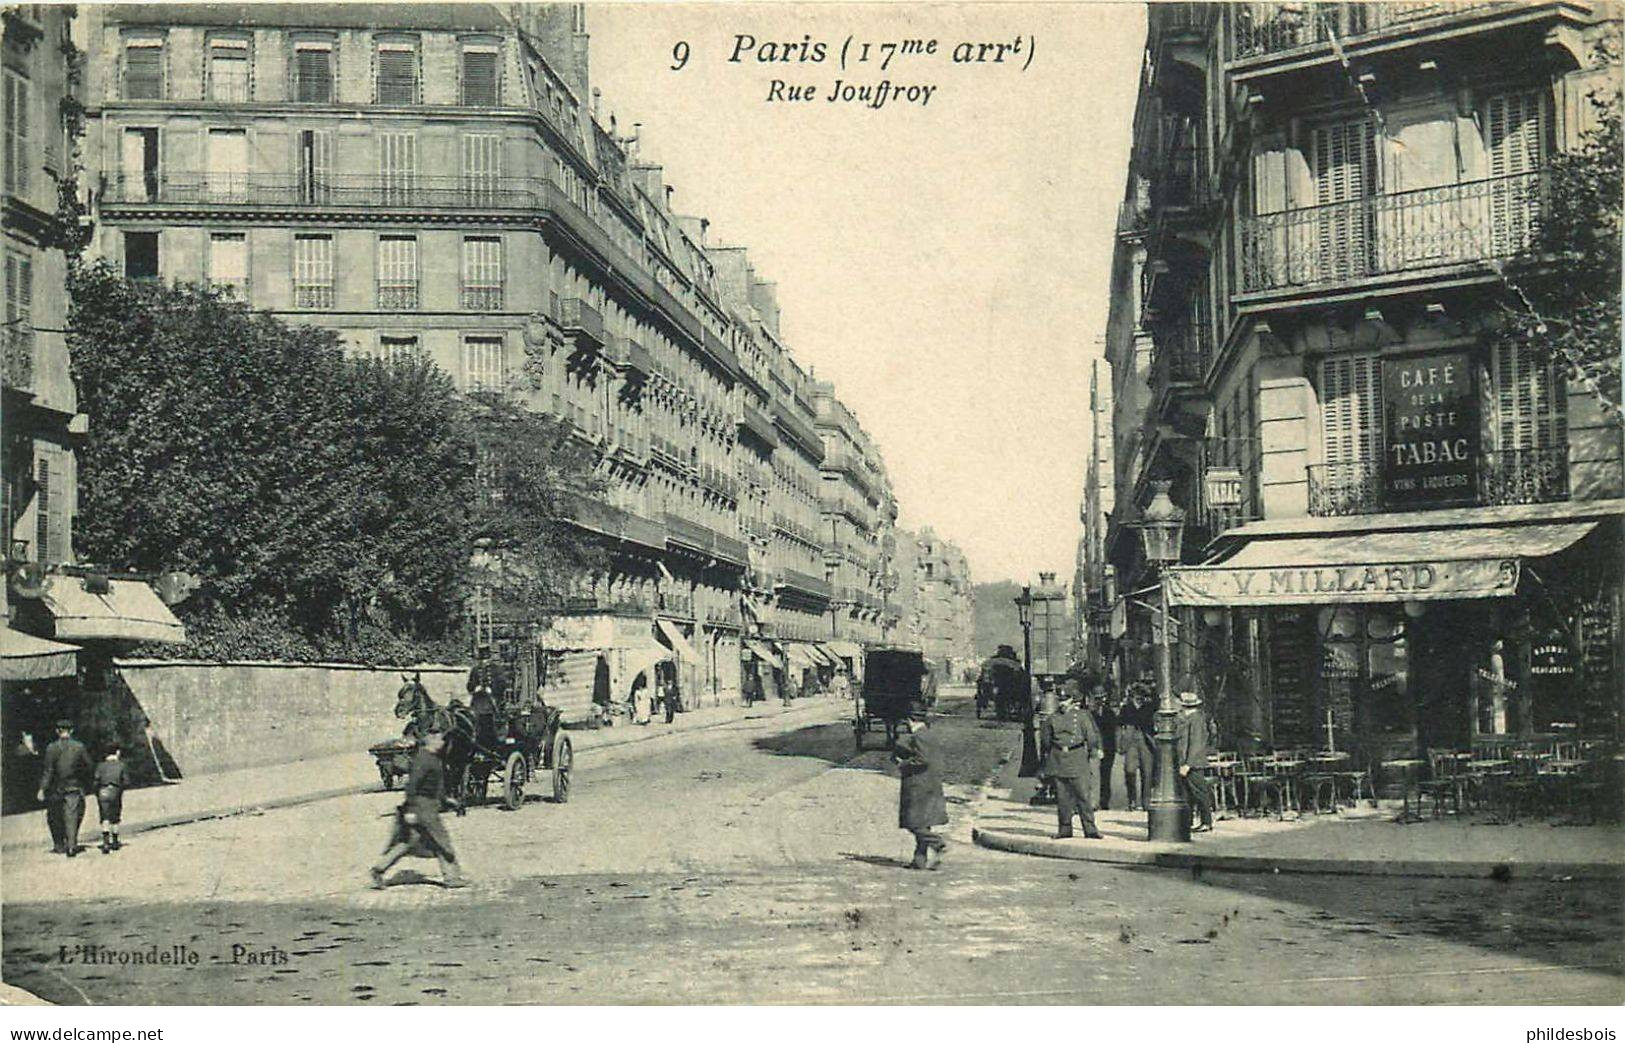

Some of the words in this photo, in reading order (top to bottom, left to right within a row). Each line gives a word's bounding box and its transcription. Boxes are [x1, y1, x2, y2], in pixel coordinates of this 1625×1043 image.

[1401, 363, 1455, 388] CAFÉ
[1400, 412, 1457, 430] POSTE
[1391, 439, 1468, 465] TABAC
